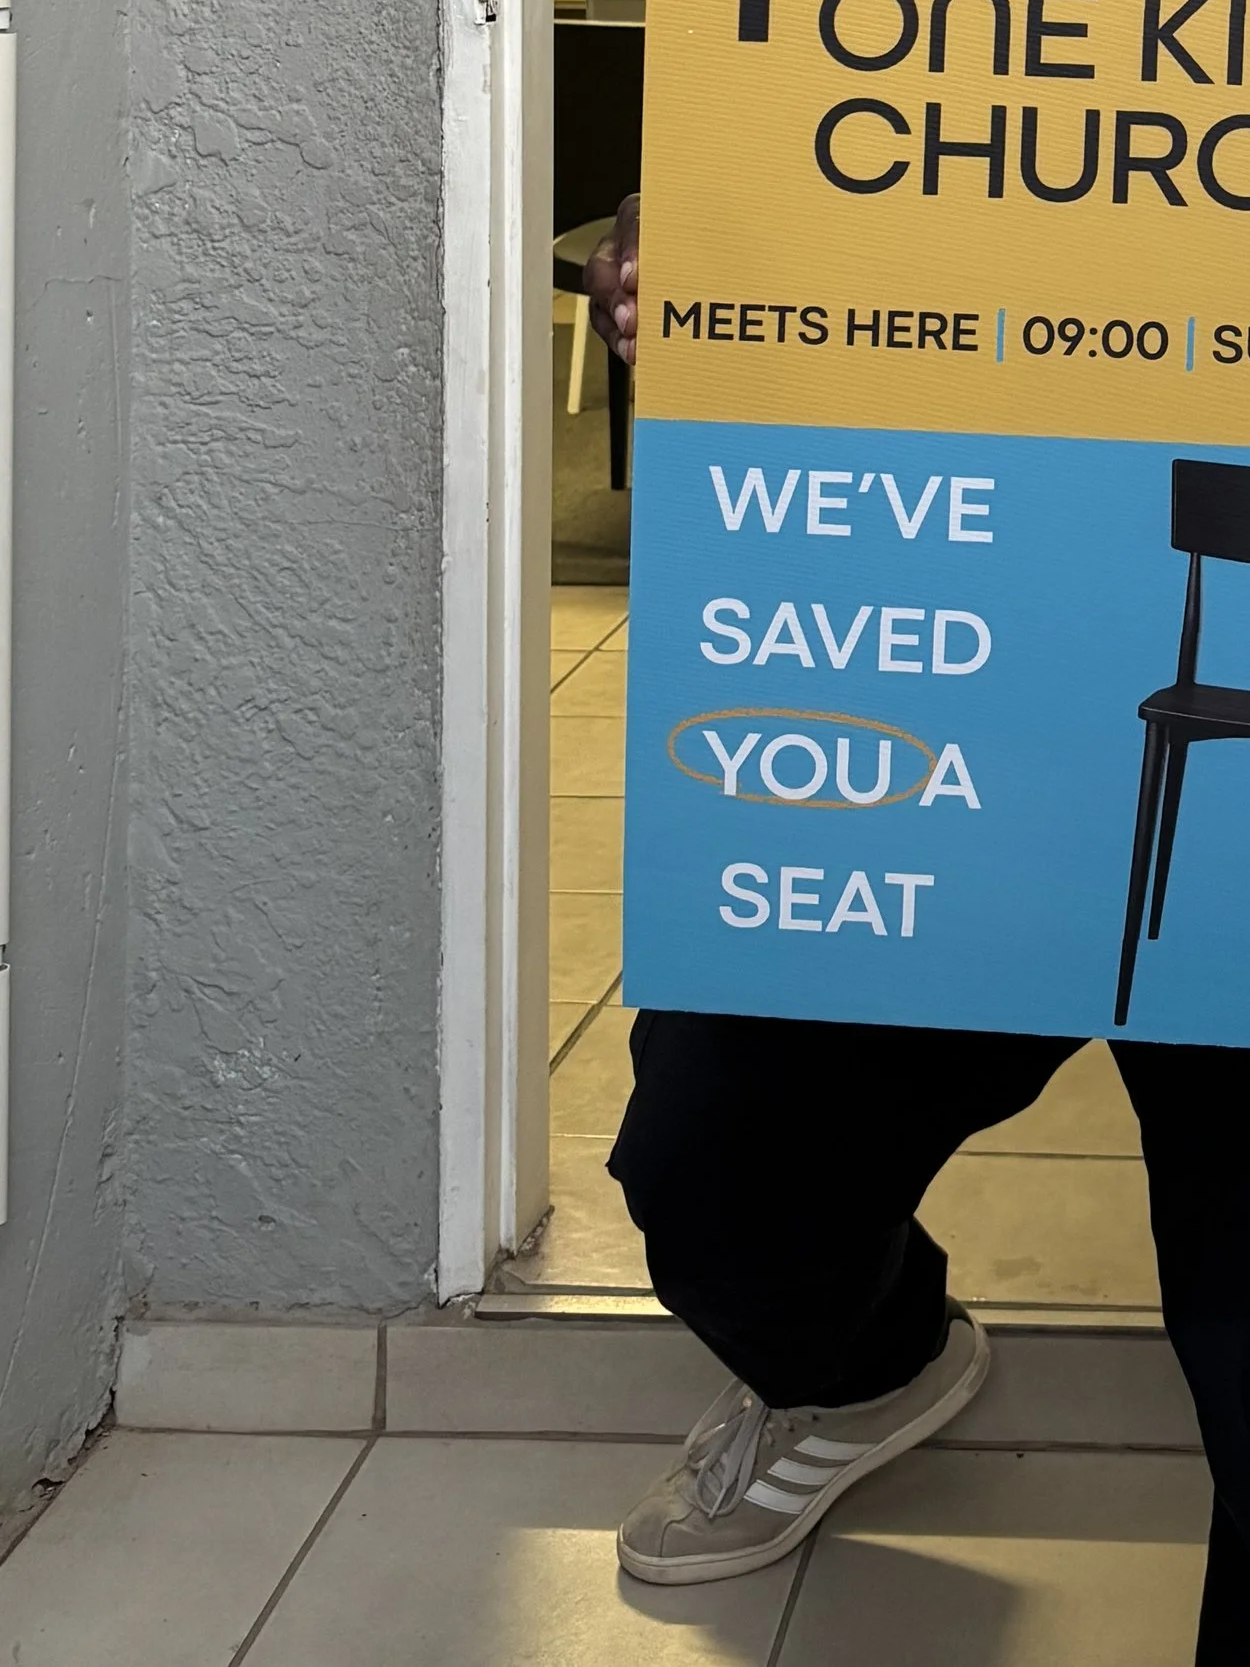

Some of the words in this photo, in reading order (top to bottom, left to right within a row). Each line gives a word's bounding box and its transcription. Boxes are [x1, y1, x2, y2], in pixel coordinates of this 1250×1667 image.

[663, 300, 829, 346] MEETS
[846, 309, 980, 352] HERE
[1022, 315, 1169, 361] 09:00
[708, 466, 996, 543] WE'VE
[700, 597, 992, 675] SAVED
[702, 730, 892, 805] YOU
[919, 743, 982, 809] A
[719, 863, 935, 937] SEAT
